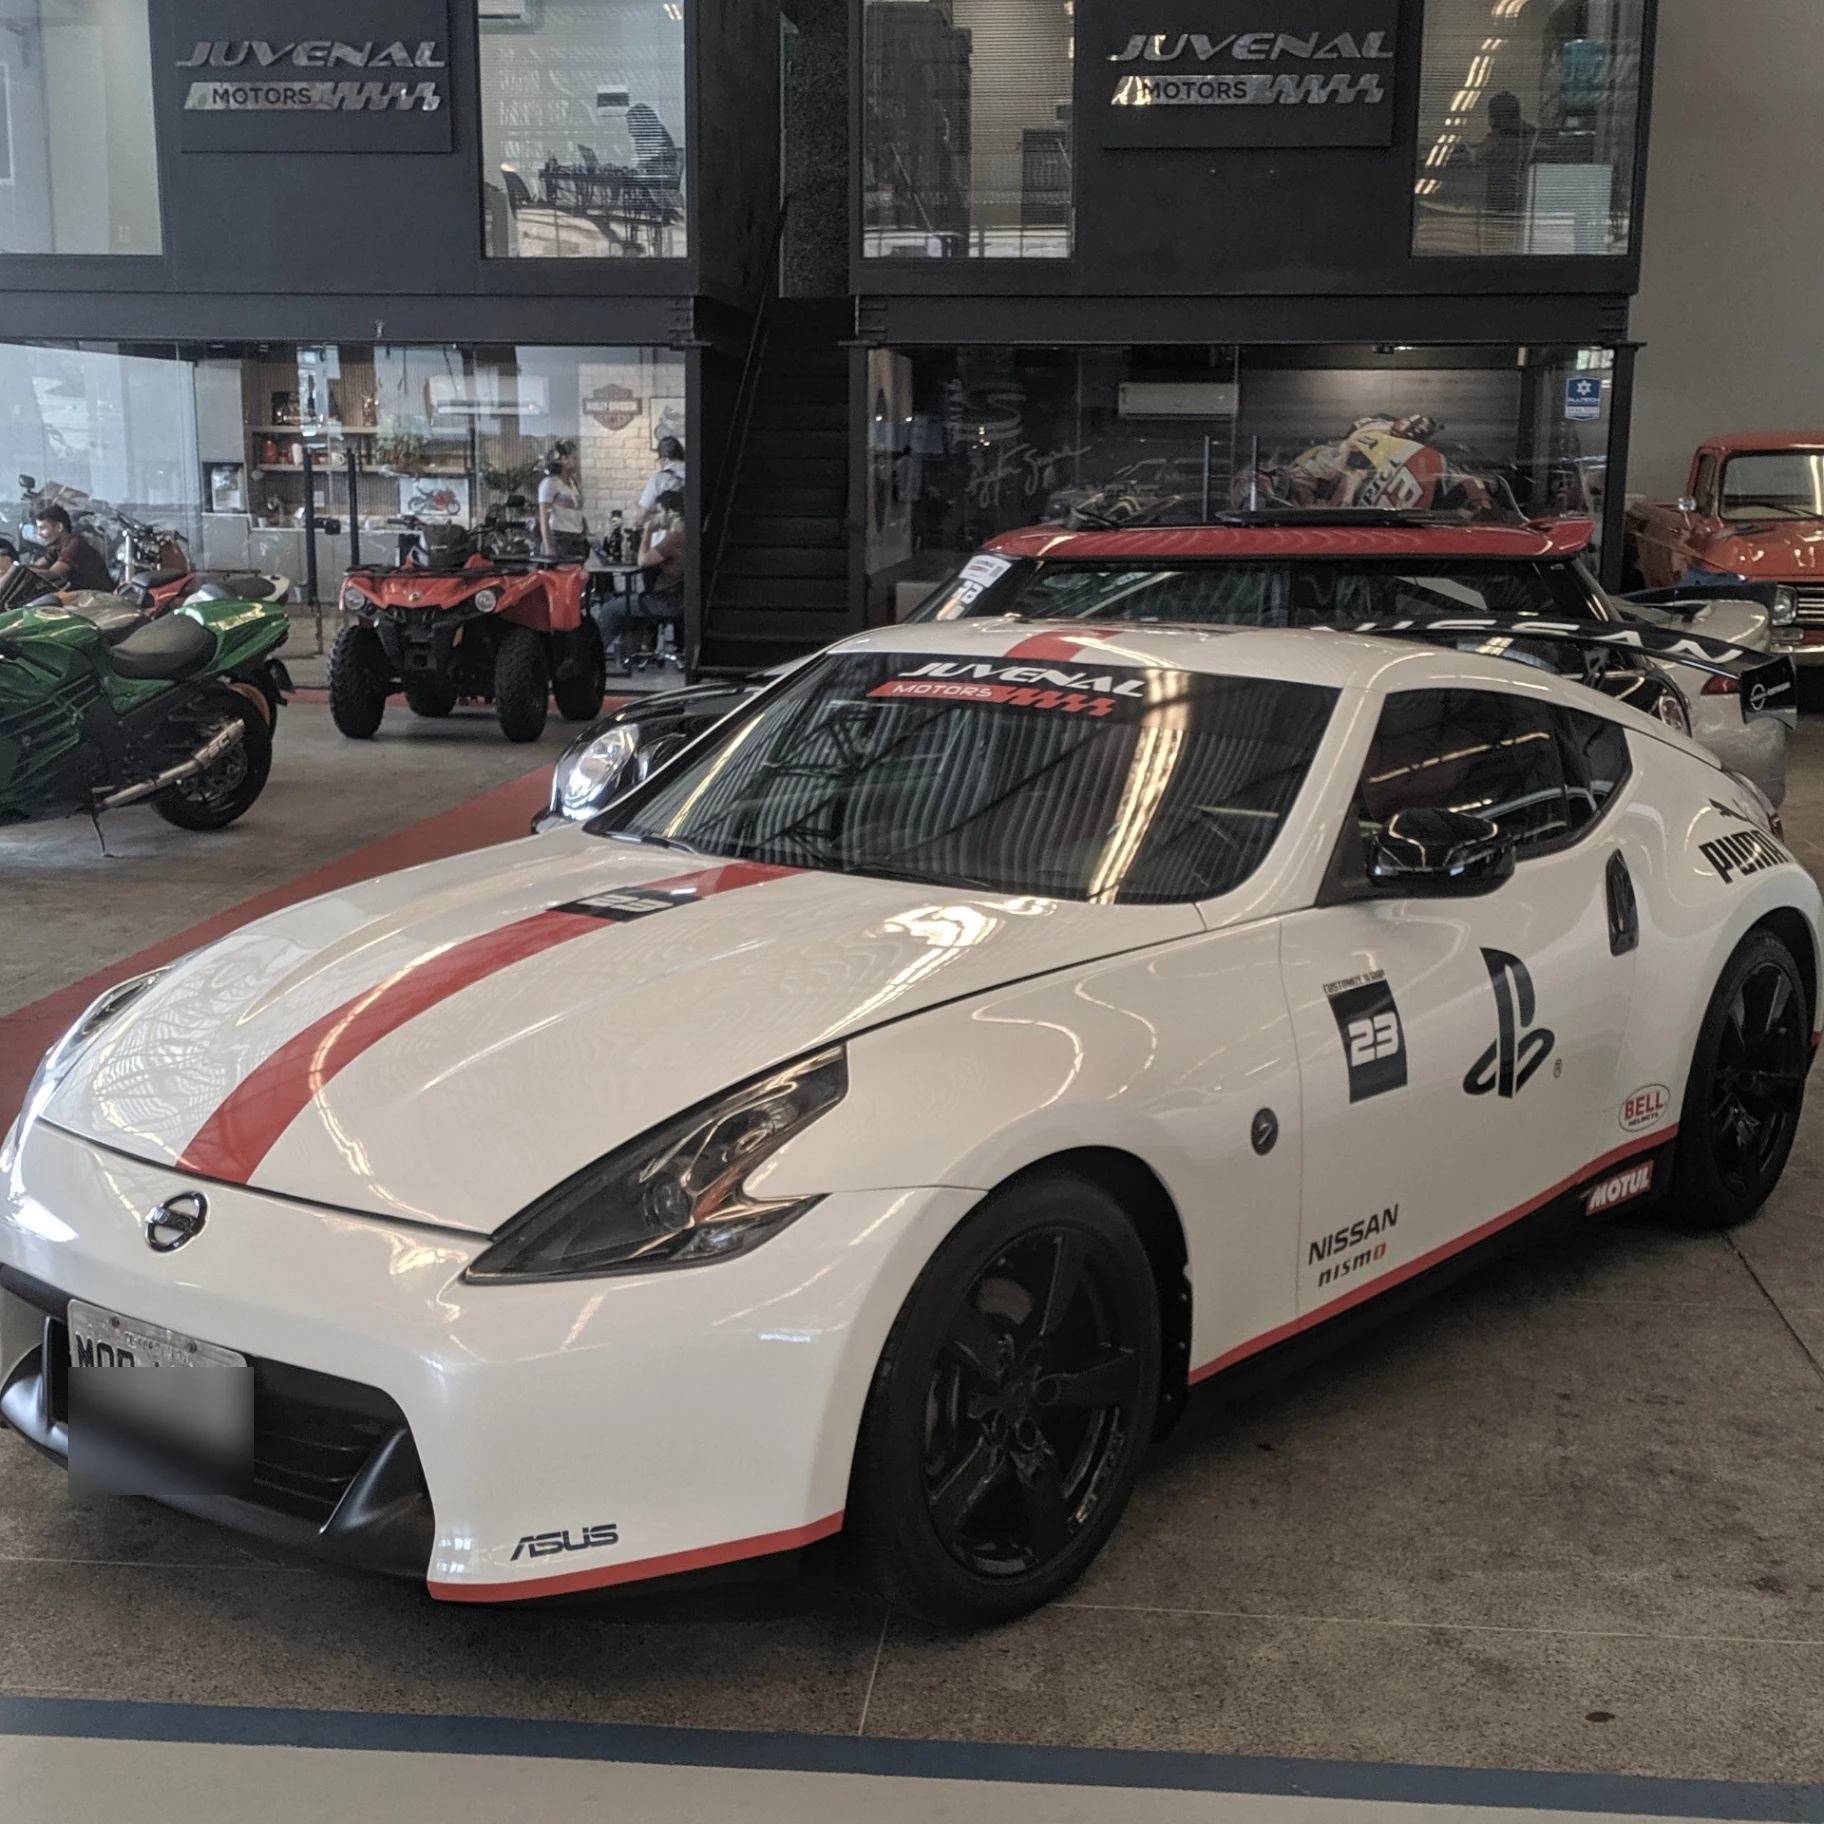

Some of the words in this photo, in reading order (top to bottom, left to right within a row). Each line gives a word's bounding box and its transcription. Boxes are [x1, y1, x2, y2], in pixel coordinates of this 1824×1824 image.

[175, 41, 446, 68] JUVENAL
[1107, 31, 1394, 61] JUVENAL
[212, 87, 312, 104] MOTORS
[1143, 81, 1248, 99] MOTORS
[892, 684, 993, 698] MOTORS
[898, 662, 1146, 698] JUVENAL
[1698, 830, 1789, 884] PUMA
[575, 894, 674, 913] 23
[1348, 1011, 1399, 1068] 23
[1625, 1091, 1664, 1120] BELL
[1588, 1166, 1650, 1210] MOTUL
[1308, 1203, 1399, 1266] NISSAN
[510, 1523, 619, 1562] ASUS
